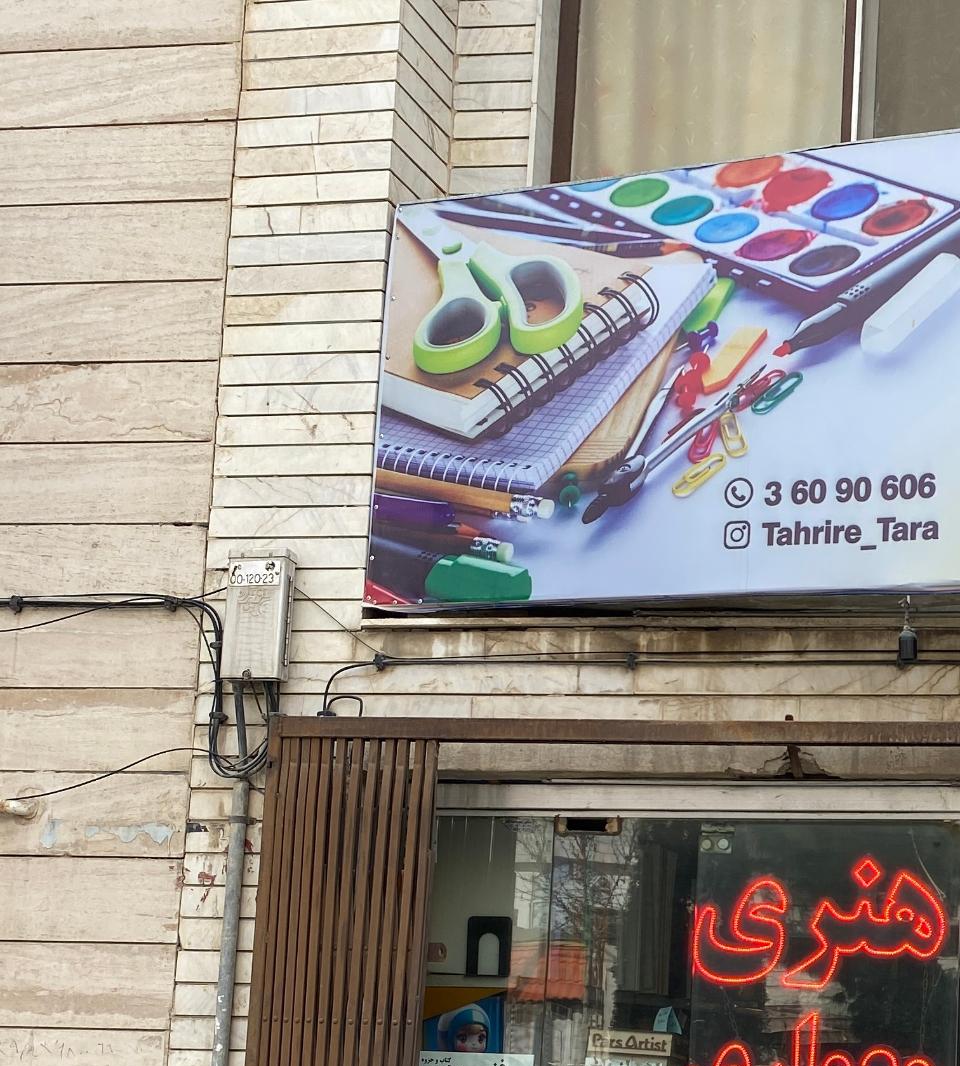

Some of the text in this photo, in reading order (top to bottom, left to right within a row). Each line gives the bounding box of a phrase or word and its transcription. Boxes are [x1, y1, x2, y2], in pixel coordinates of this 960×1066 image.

[764, 473, 936, 506] 3 60 90 606
[762, 516, 939, 550] Tahrire_Tara
[691, 855, 950, 991] هنری
[625, 1035, 667, 1051] Artist
